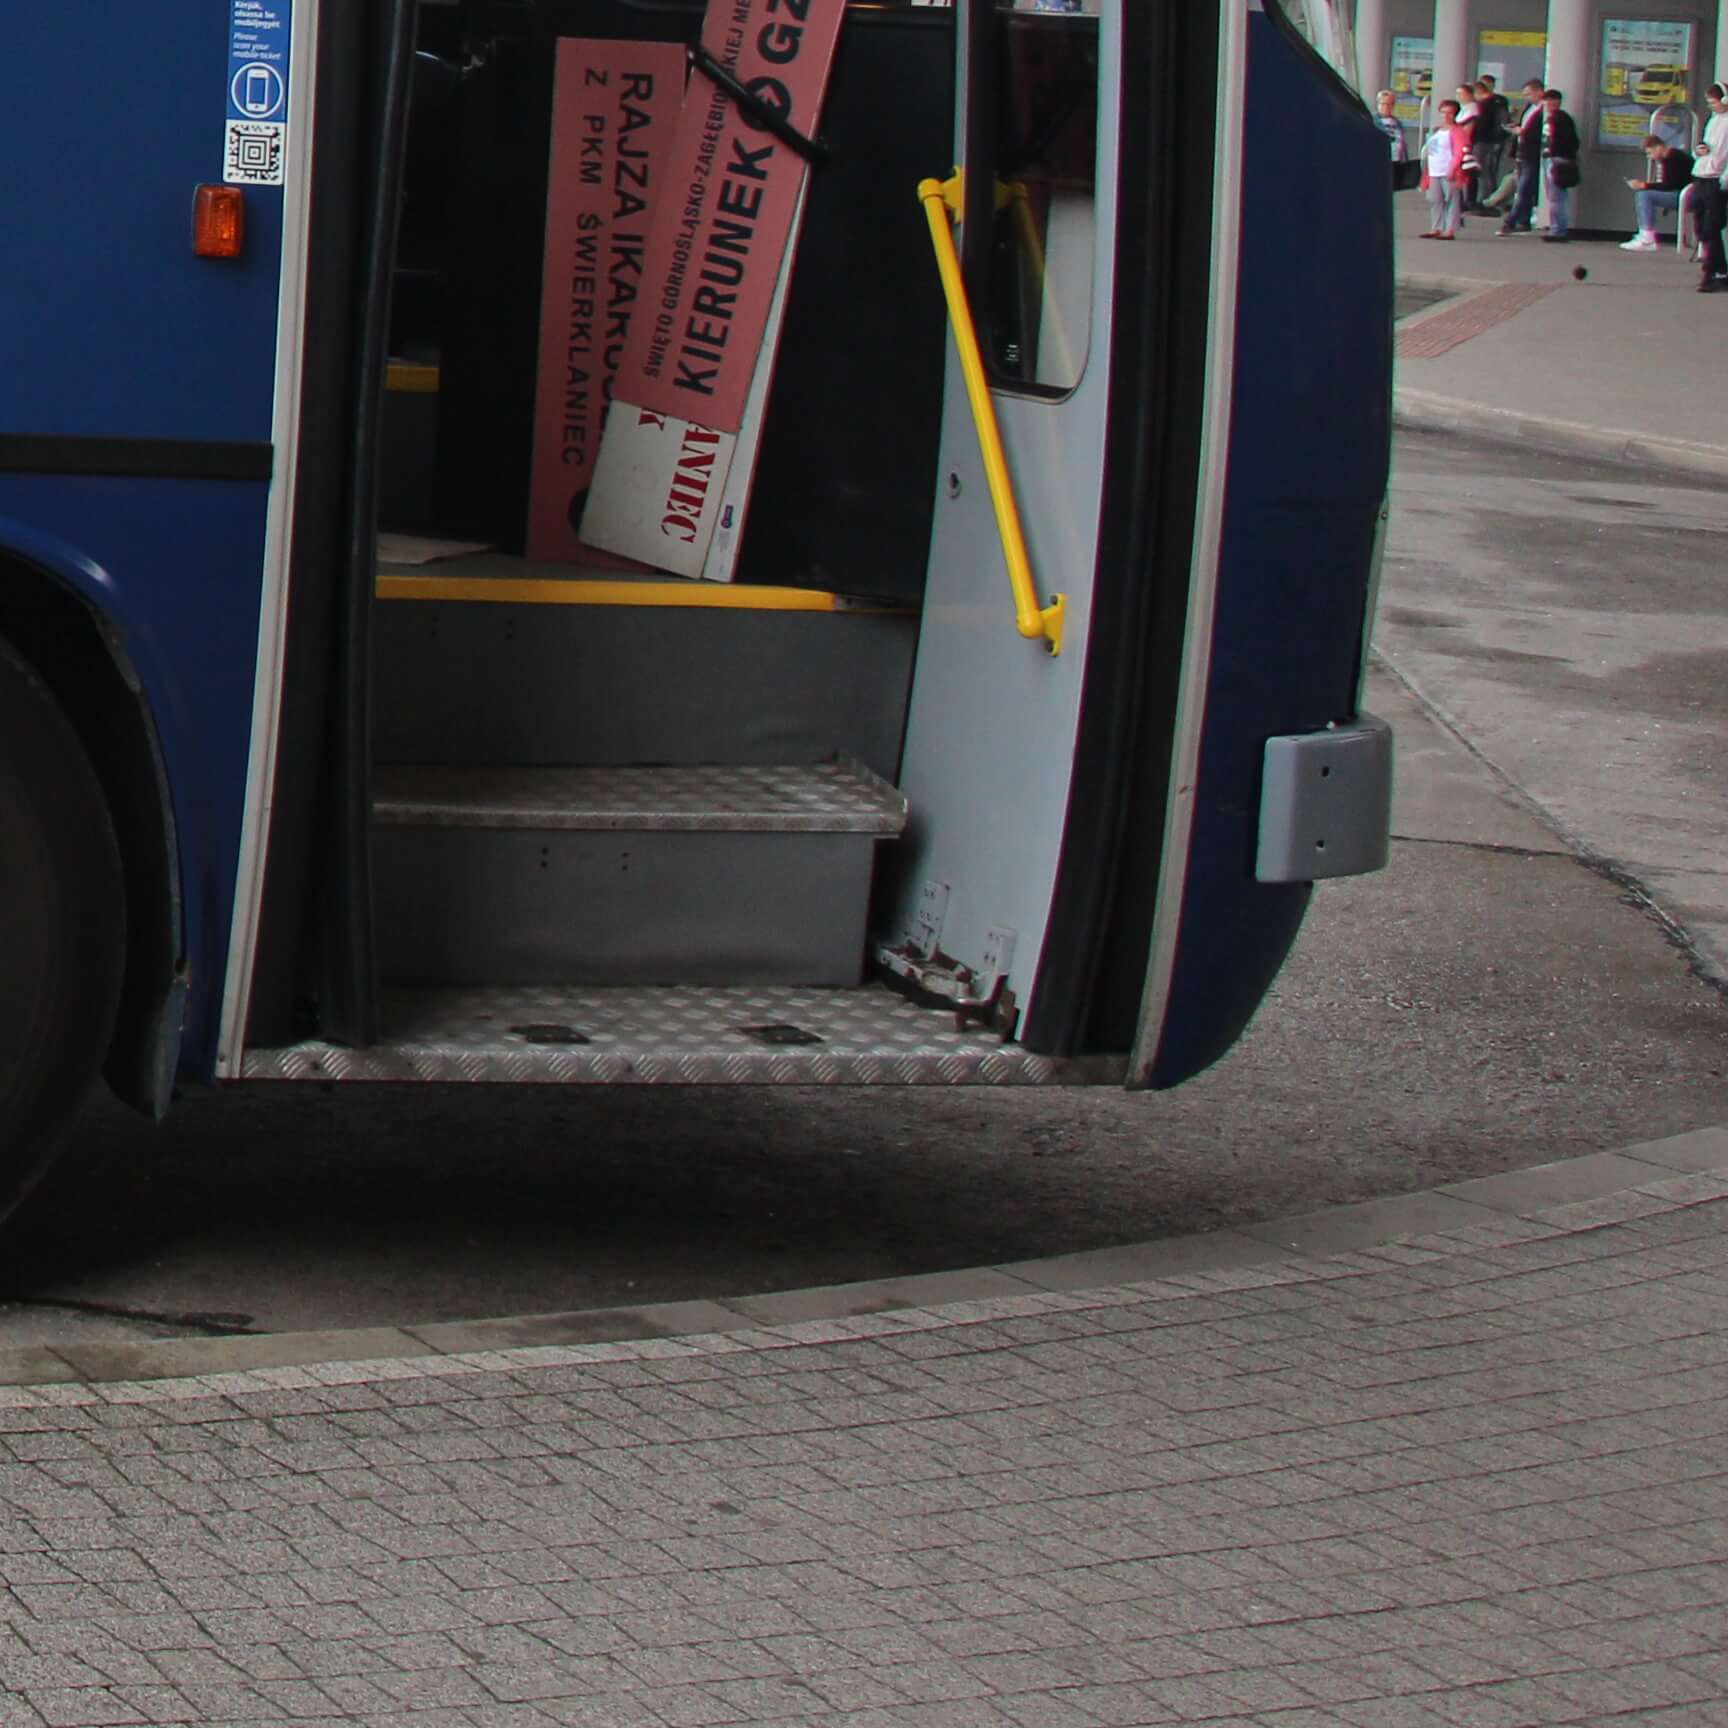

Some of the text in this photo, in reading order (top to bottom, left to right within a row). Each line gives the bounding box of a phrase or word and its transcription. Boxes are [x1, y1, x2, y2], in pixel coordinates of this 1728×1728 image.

[562, 69, 608, 466] Z PKM ŚWIERKLANIEC
[612, 71, 654, 219] RAJZA
[644, 313, 674, 378] ŚWIĘTO
[662, 28, 744, 309] GÓRNOŚLĄSKO-ZAGŁĘBIOKIEJ
[672, 136, 774, 395] KIERUNEK
